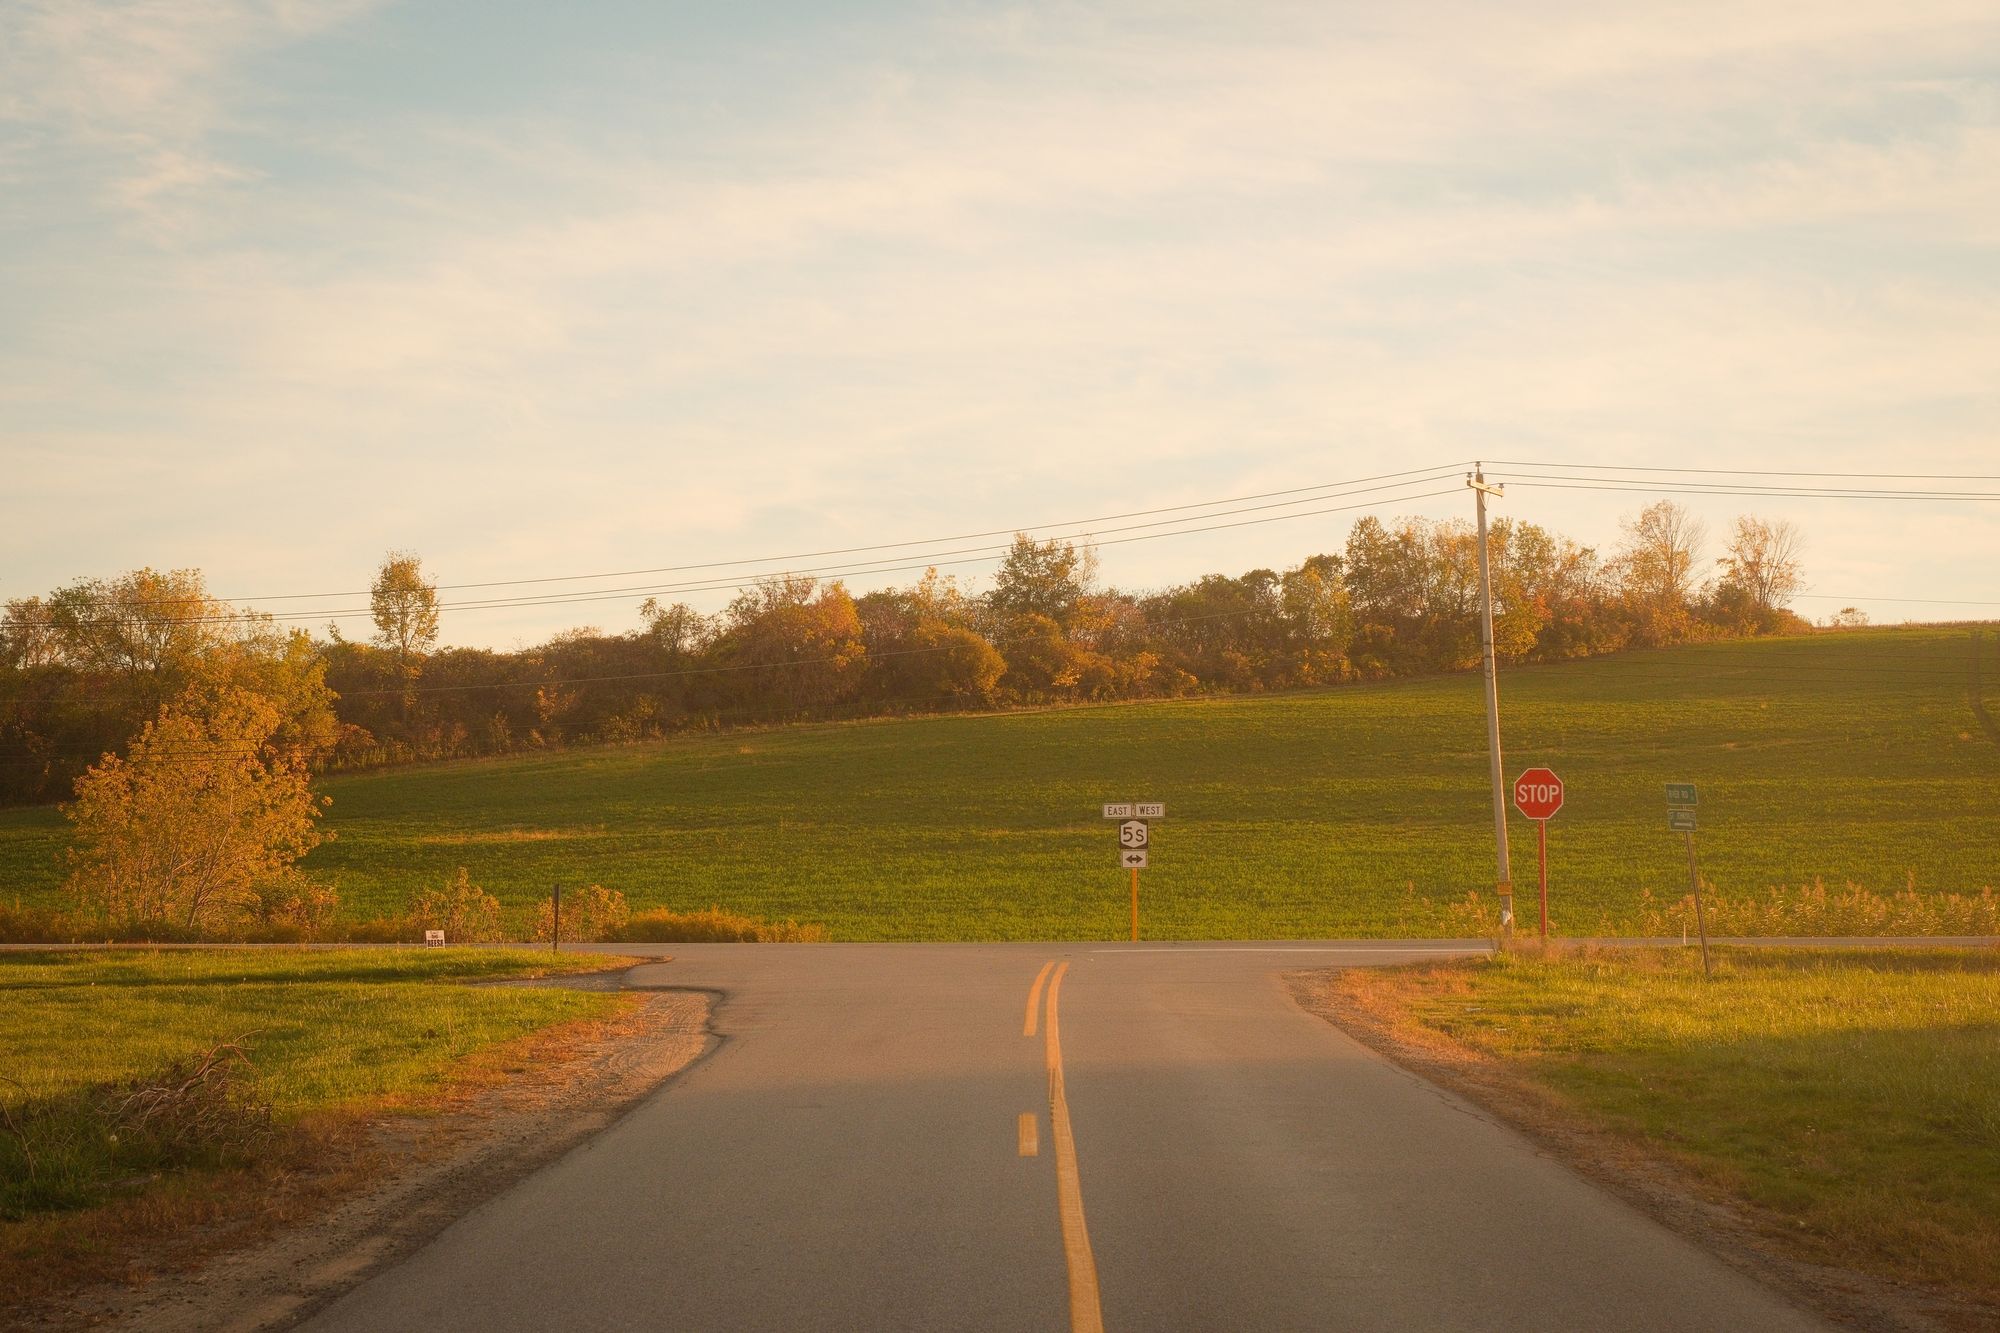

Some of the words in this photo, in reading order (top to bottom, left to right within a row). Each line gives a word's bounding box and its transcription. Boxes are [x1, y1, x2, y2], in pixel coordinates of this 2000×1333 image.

[1518, 784, 1559, 803] STOP
[1107, 806, 1128, 816] EAST
[1139, 805, 1160, 815] WEST
